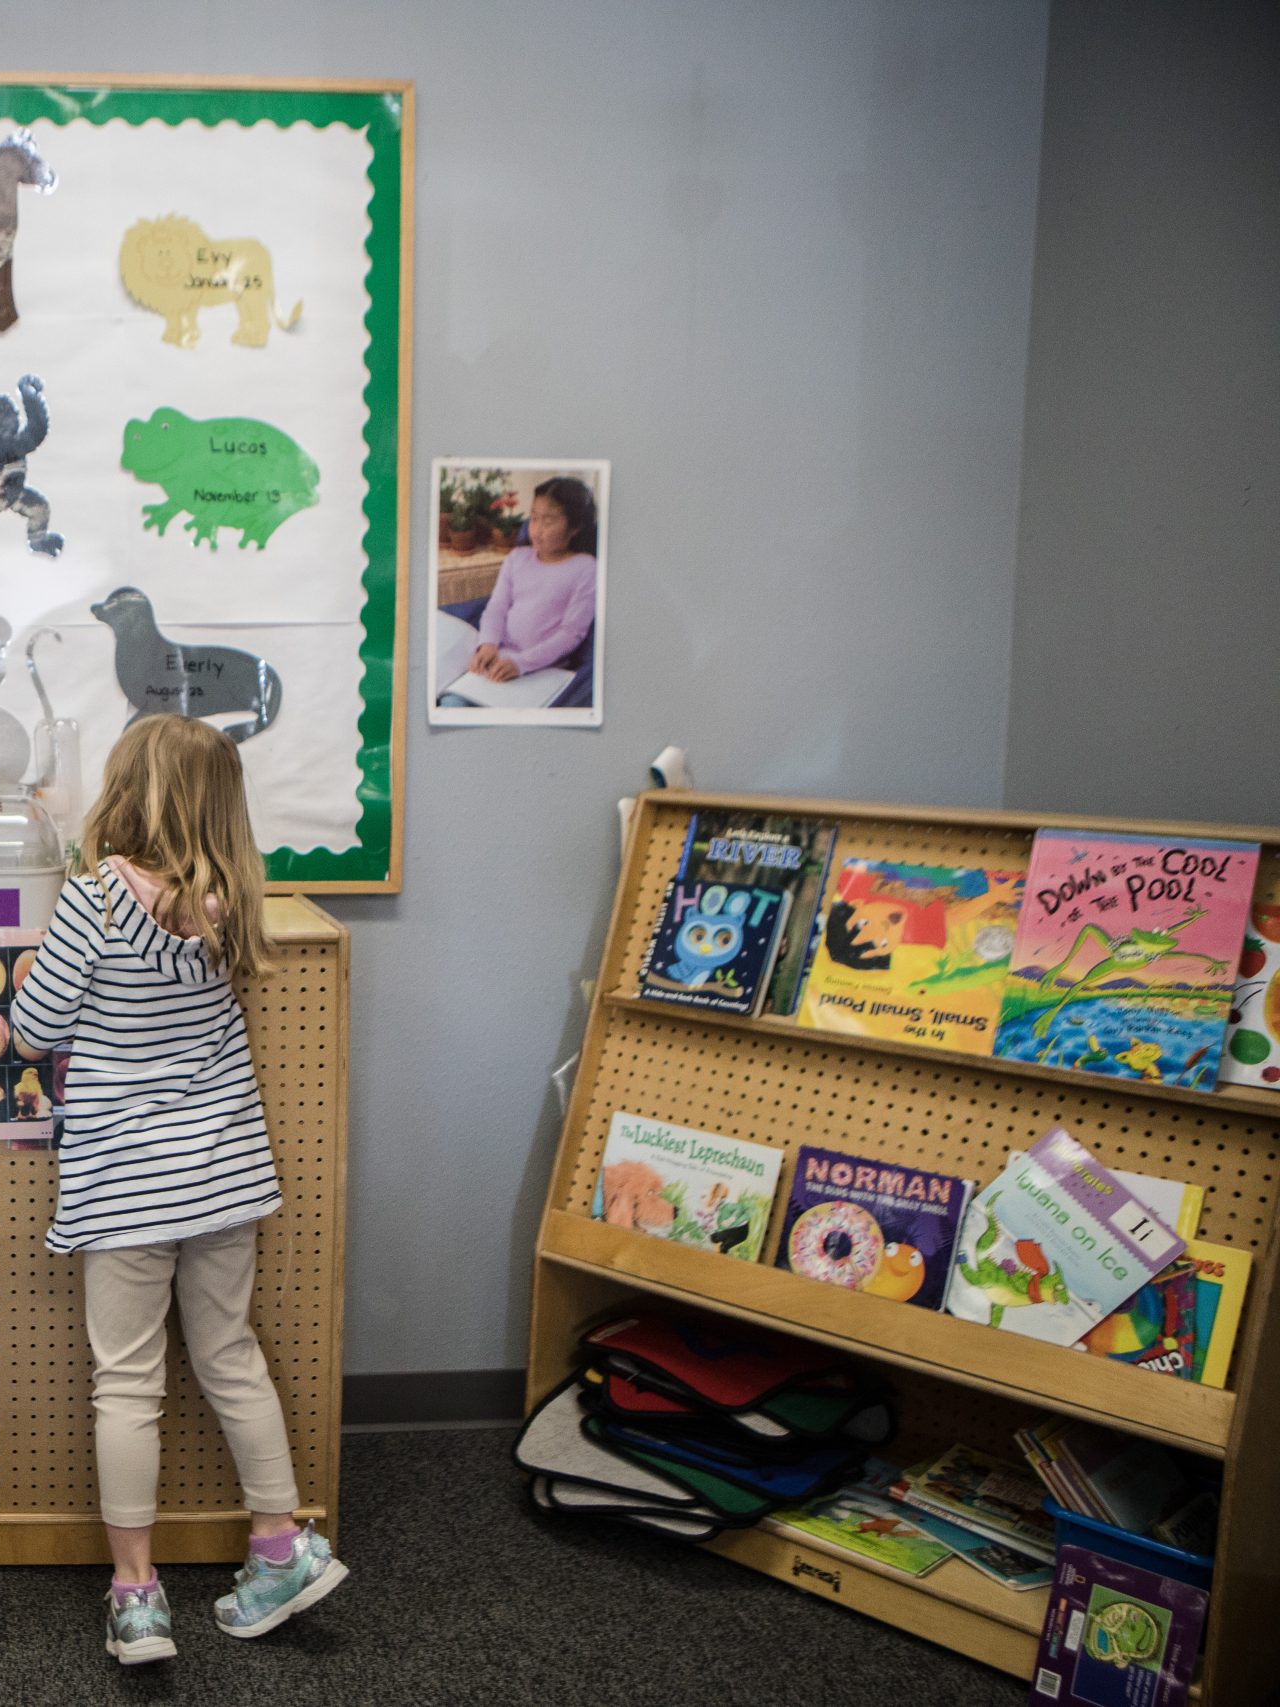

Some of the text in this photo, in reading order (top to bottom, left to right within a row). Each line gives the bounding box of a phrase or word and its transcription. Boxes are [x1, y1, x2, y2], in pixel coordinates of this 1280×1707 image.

[196, 247, 233, 269] Evy
[208, 436, 268, 456] Lucas
[145, 685, 183, 702] Augus
[706, 837, 803, 870] RIVER
[1037, 866, 1107, 916] DOWN
[1161, 848, 1232, 883] COOL
[1126, 874, 1196, 912] POOL
[673, 883, 781, 928] HOOT
[820, 993, 865, 1014] Pond
[871, 1001, 924, 1023] Small
[904, 1024, 946, 1041] In the
[634, 1124, 687, 1153] Luckiest
[689, 1139, 766, 1177] Leprechaun
[804, 1156, 953, 1204] NORMAN
[1071, 1223, 1098, 1252] on
[1097, 1246, 1129, 1282] Ice
